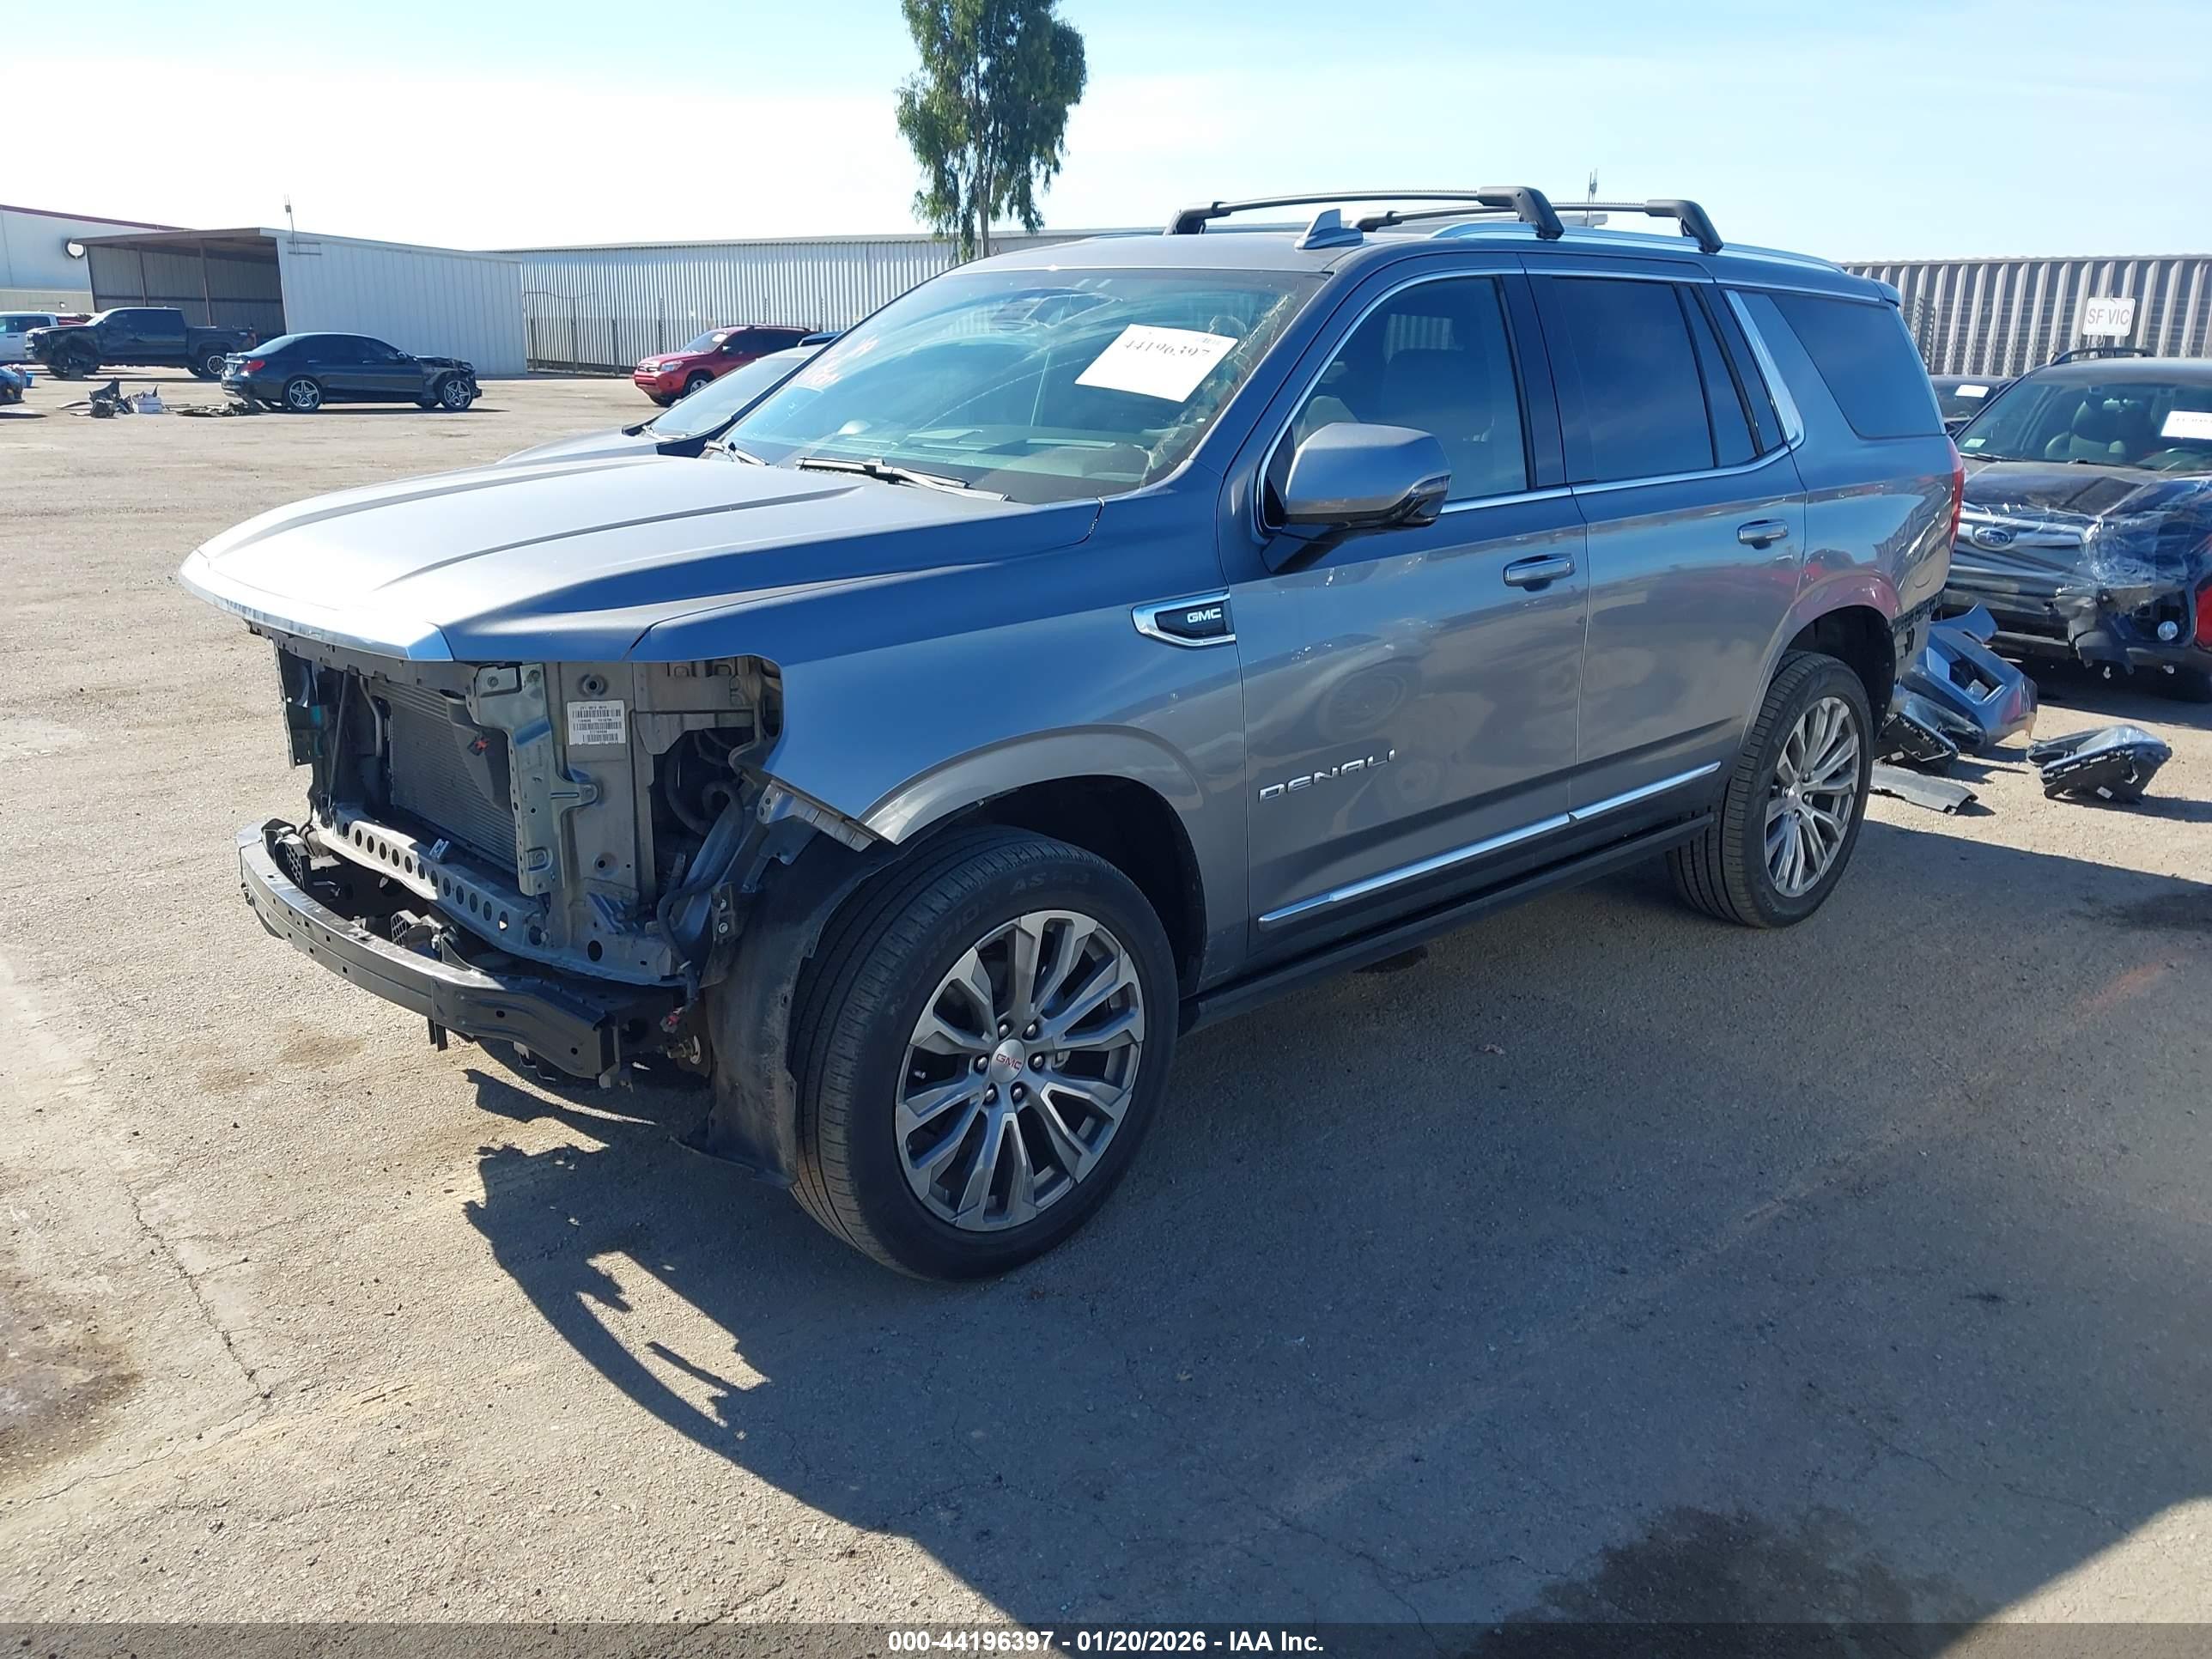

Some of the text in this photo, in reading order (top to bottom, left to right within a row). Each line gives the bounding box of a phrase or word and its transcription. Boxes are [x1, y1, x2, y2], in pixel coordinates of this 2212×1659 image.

[2087, 308, 2130, 325] SF VIC
[1187, 608, 1222, 623] GMC
[1258, 748, 1395, 803] DENALI
[996, 1054, 1022, 1071] GMC
